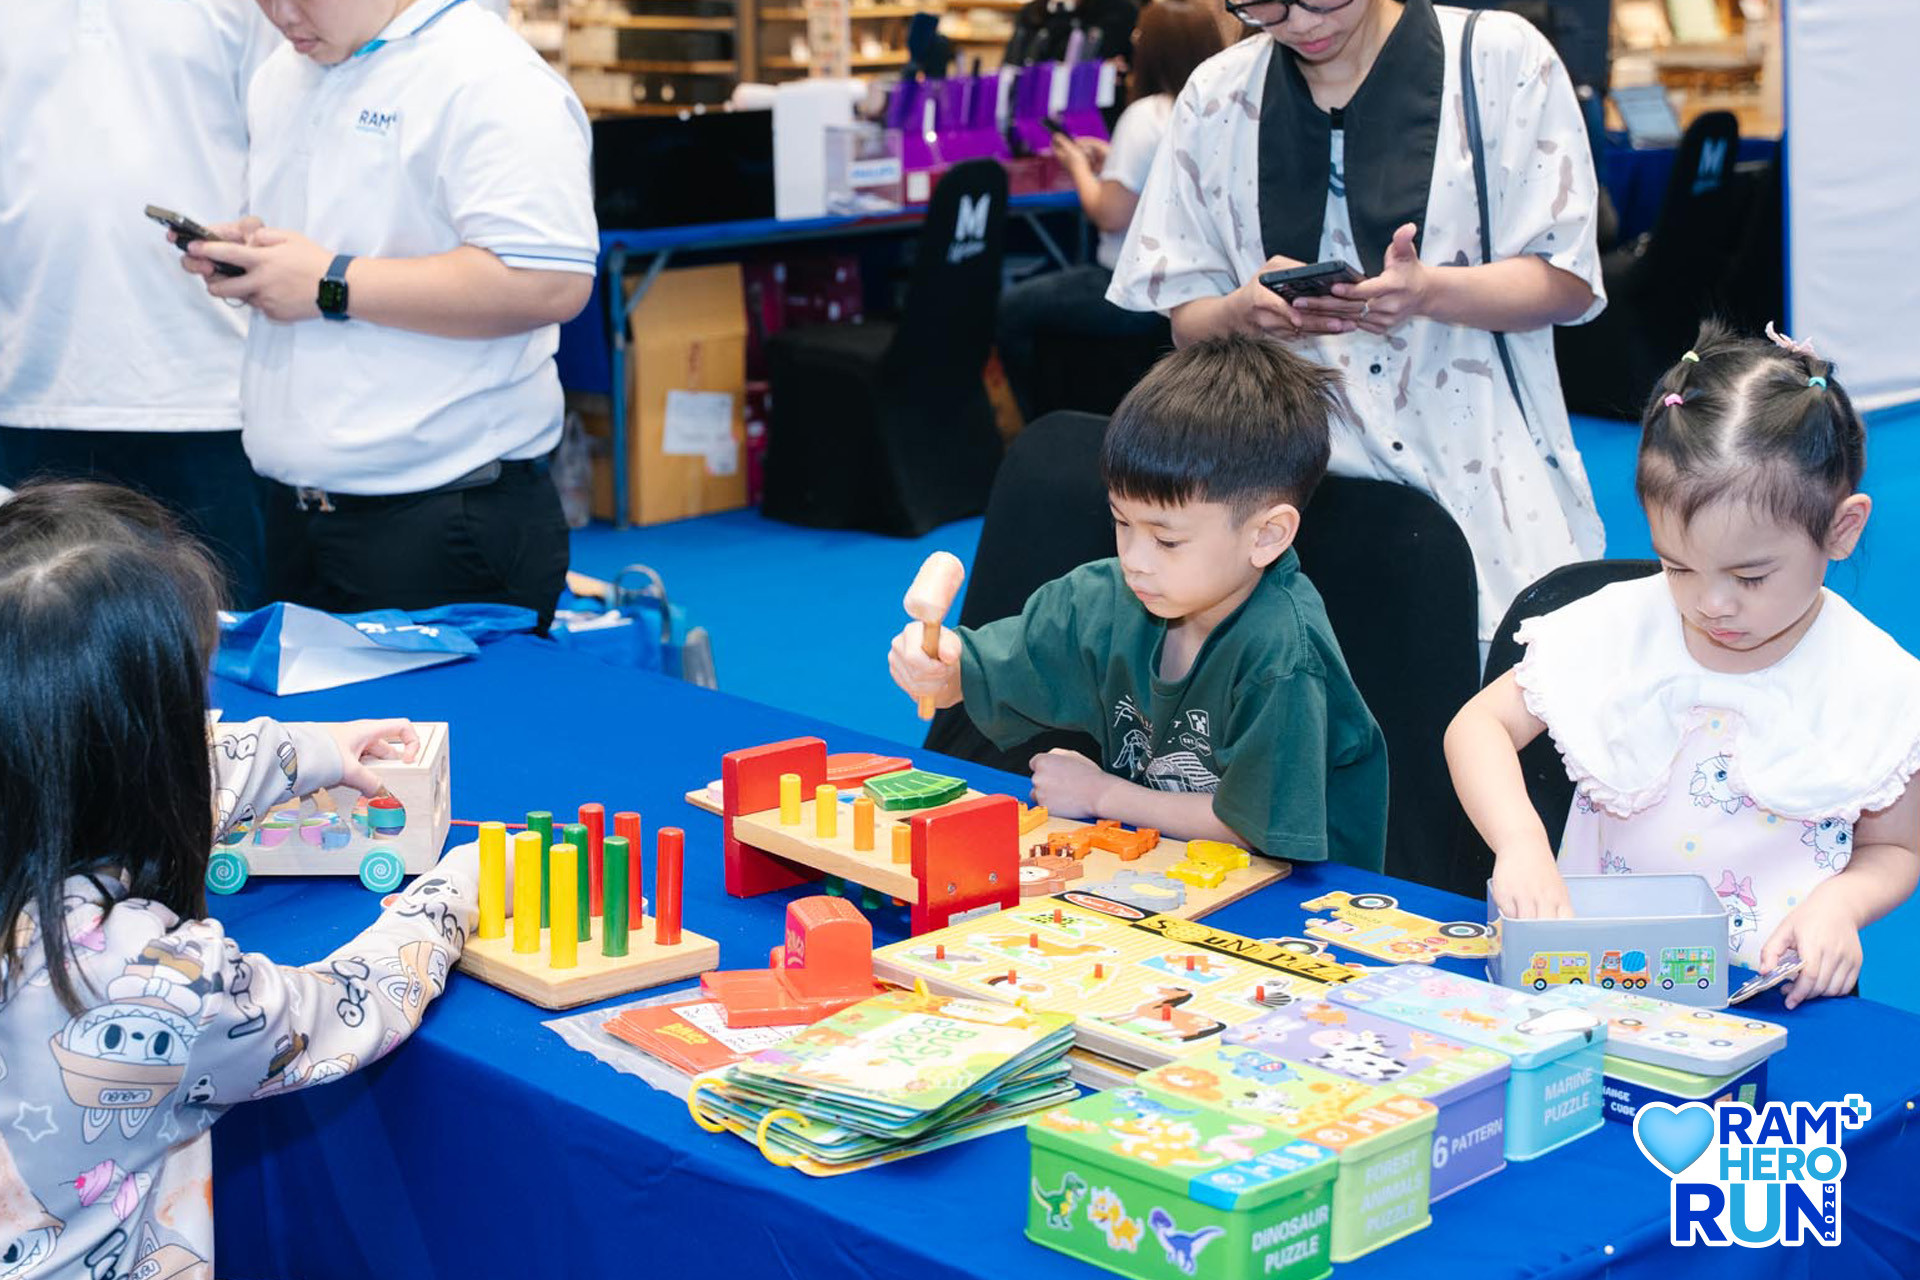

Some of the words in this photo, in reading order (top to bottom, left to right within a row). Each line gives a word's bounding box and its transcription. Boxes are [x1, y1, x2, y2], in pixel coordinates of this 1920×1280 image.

[954, 192, 991, 241] M
[876, 1018, 956, 1054] BOOK
[888, 1028, 979, 1067] BUSY
[1545, 1067, 1593, 1101] MARINE
[1545, 1091, 1589, 1126] PUZZLE
[1432, 1136, 1448, 1169] 6
[1451, 1117, 1503, 1155] PATTERN
[1364, 1148, 1418, 1187] FOREST
[1360, 1170, 1424, 1214] ANIMALS
[1251, 1204, 1329, 1253] DINOSAUR
[1364, 1199, 1417, 1236] PUZZLE
[1264, 1233, 1319, 1275] PUZZLE
